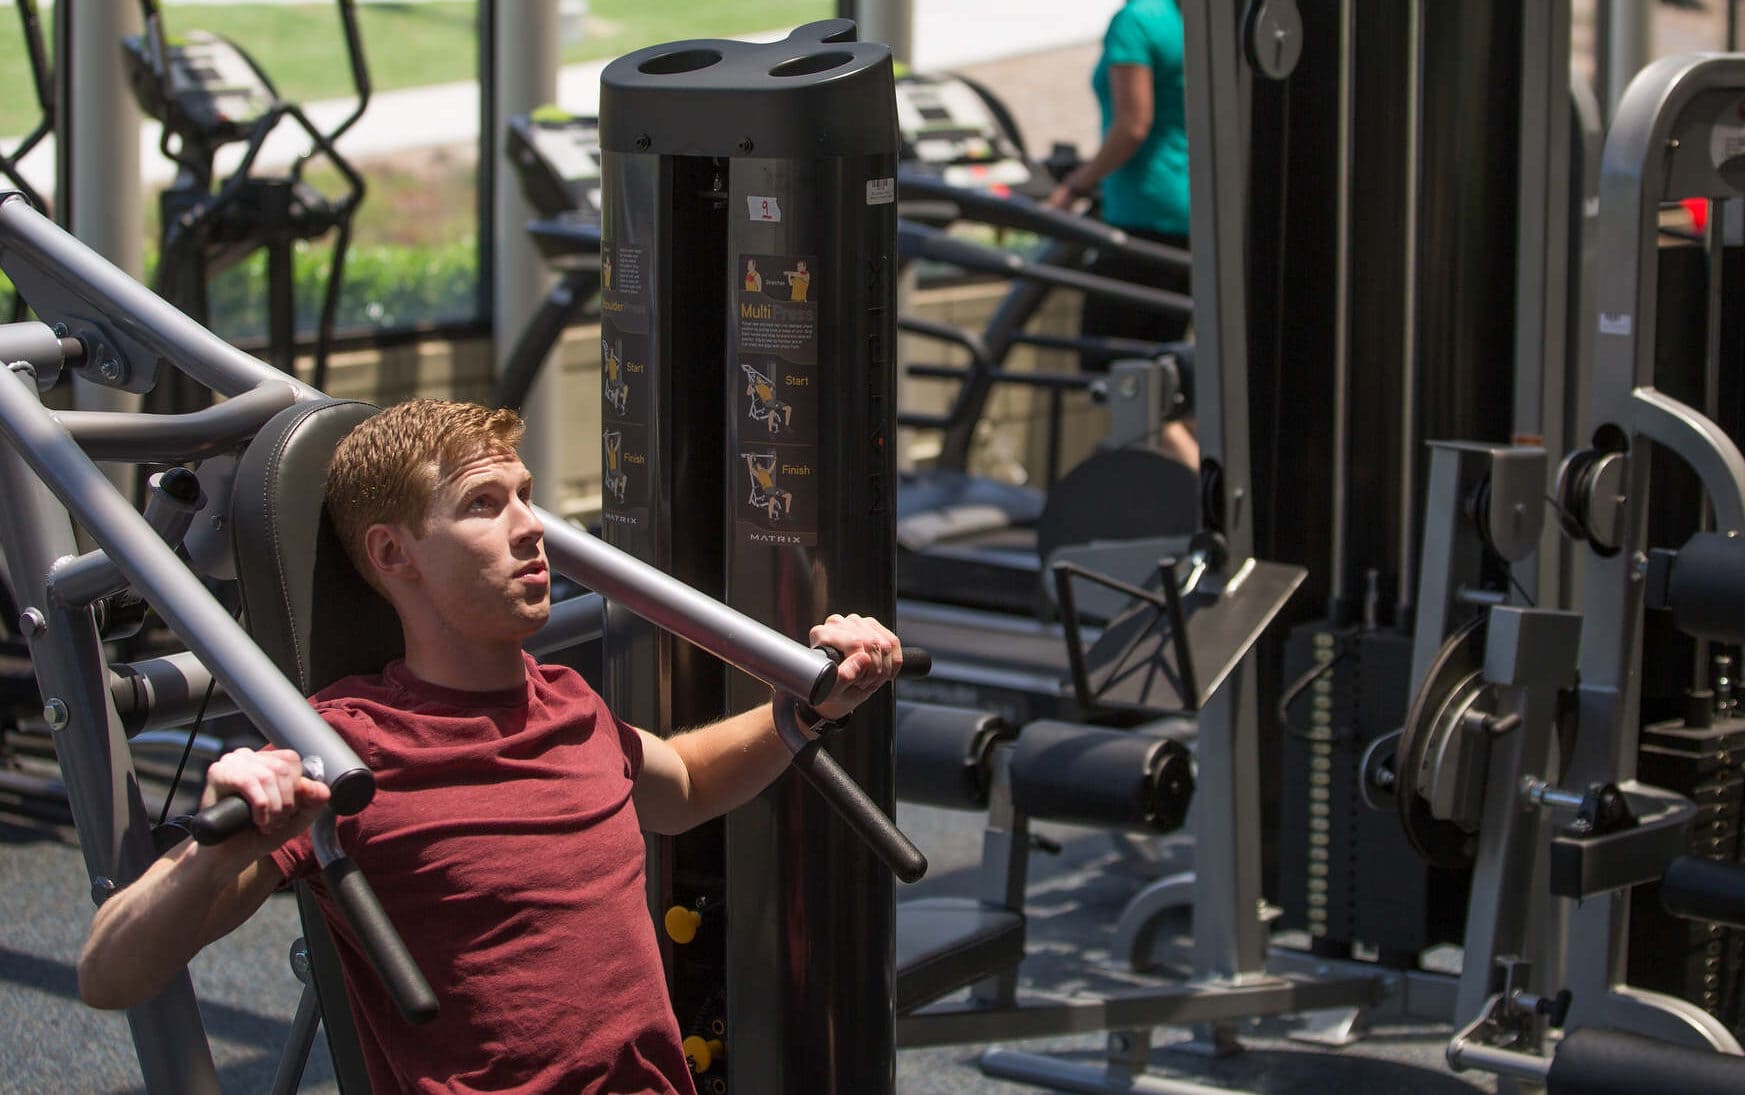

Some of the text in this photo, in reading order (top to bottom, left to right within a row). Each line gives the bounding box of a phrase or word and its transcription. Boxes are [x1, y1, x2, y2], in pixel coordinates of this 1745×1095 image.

[741, 303, 771, 320] Multi
[626, 361, 645, 374] Start
[784, 375, 809, 386] Start
[624, 452, 645, 465] Finish
[782, 464, 811, 475] Finish
[750, 533, 801, 543] MATRIX
